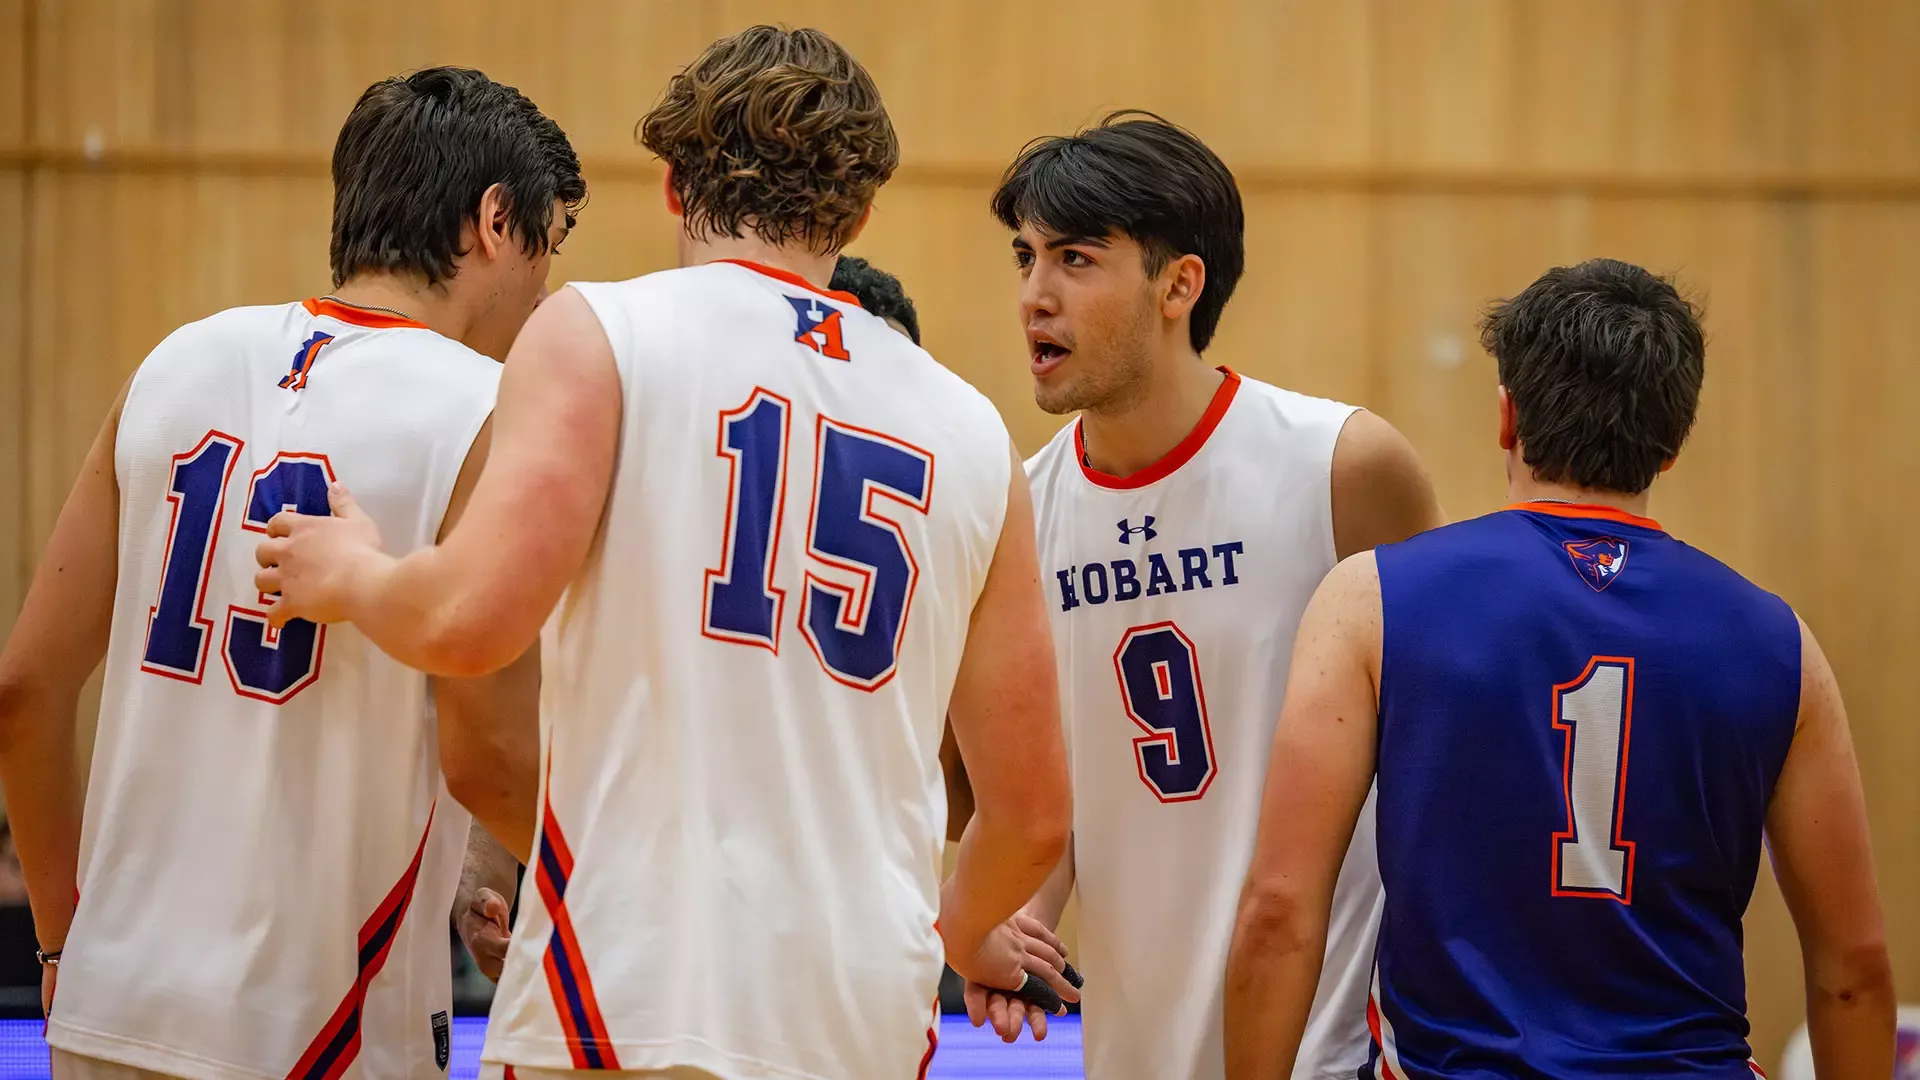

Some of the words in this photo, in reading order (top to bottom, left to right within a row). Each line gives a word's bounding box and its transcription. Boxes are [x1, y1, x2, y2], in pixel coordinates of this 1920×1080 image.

[782, 294, 850, 361] H
[141, 429, 336, 704] 13
[701, 386, 934, 692] 15
[1056, 541, 1243, 611] HOBART
[1113, 621, 1217, 803] 9
[1552, 656, 1635, 905] 1
